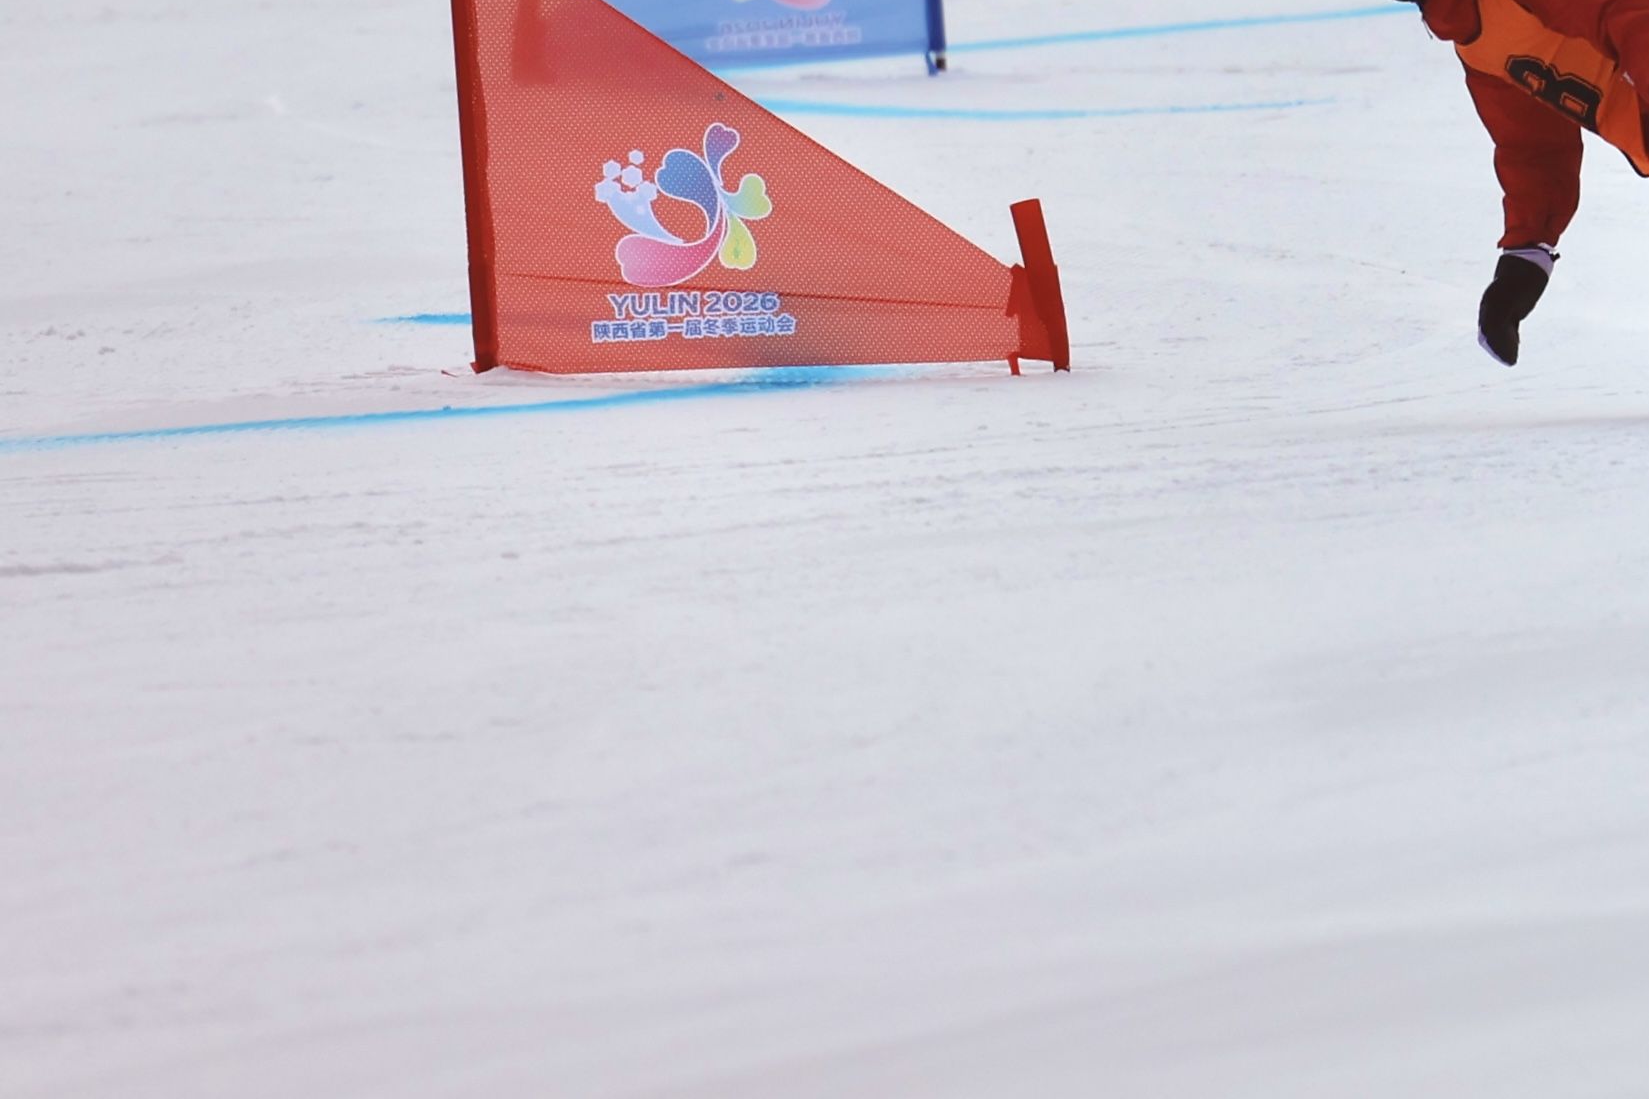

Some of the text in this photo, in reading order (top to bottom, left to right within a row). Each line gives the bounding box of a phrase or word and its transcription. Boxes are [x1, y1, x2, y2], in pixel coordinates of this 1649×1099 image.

[608, 291, 780, 318] YULIN 2026
[592, 315, 796, 342] 陕西省第一届冬季运动会
